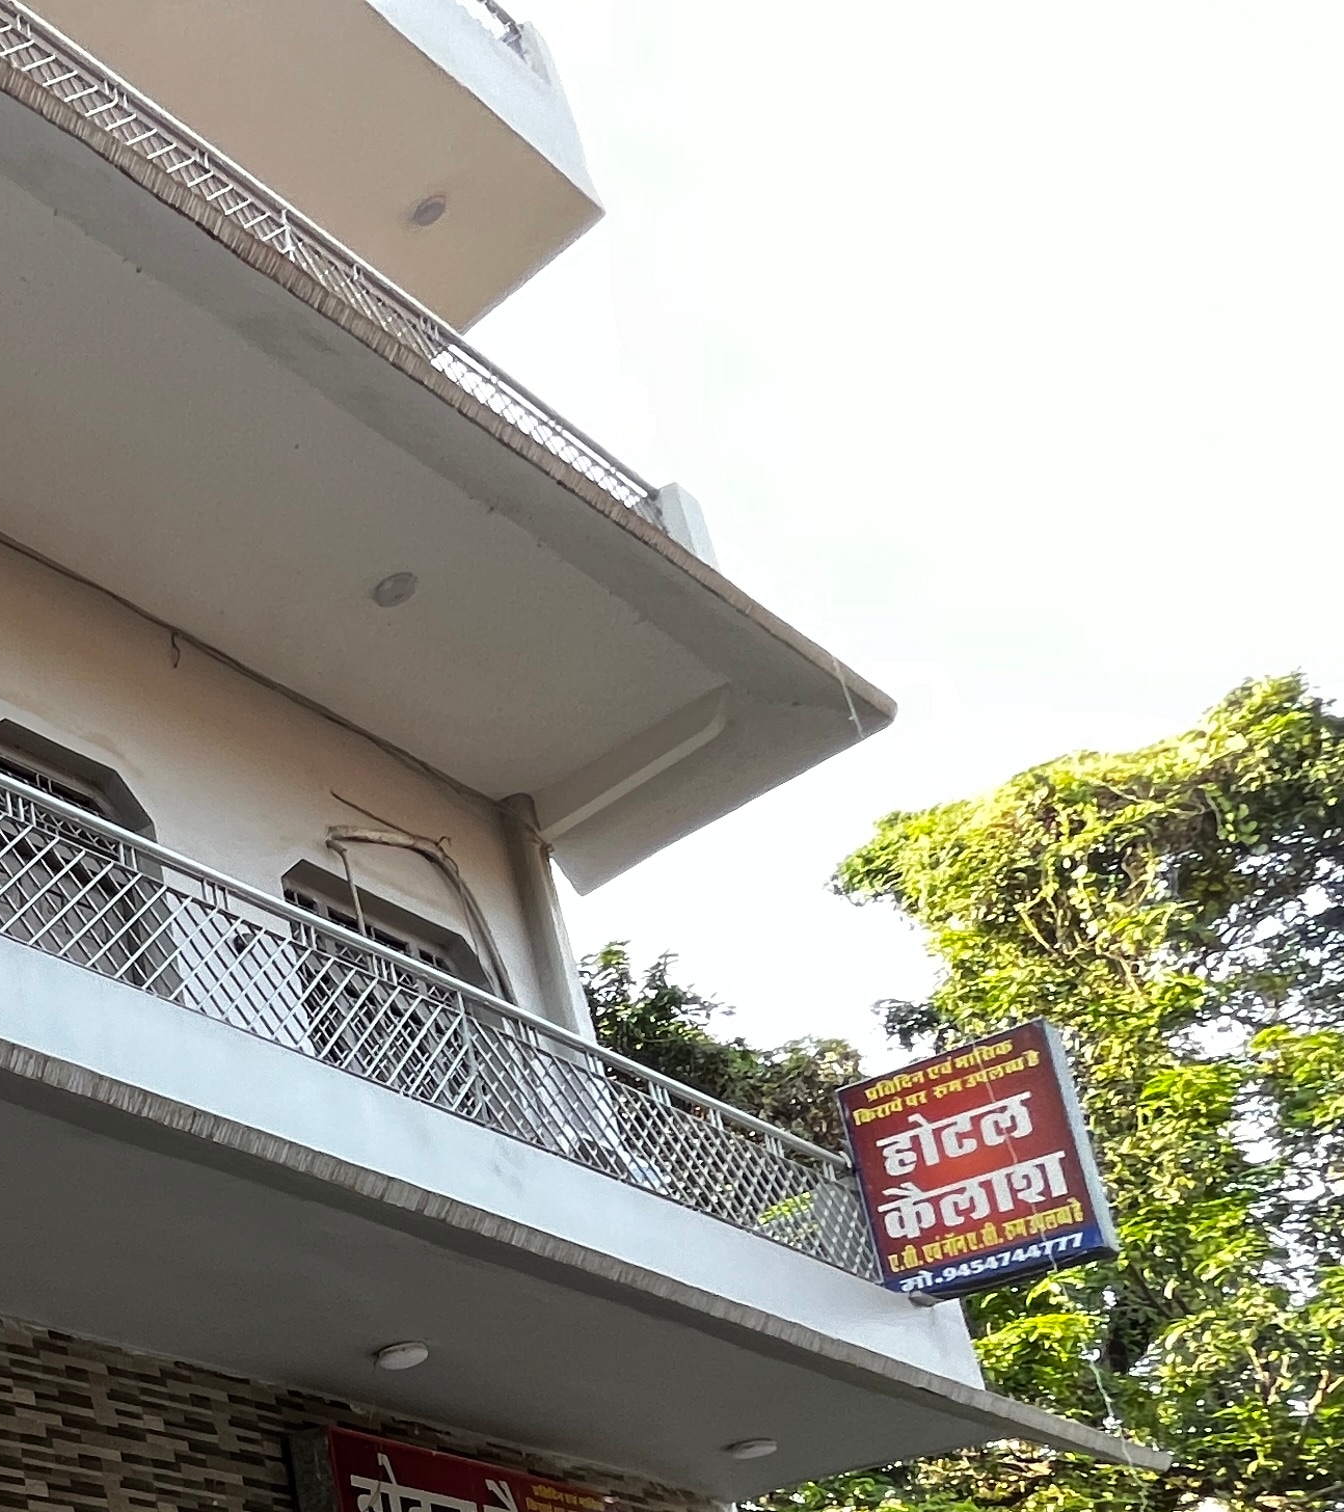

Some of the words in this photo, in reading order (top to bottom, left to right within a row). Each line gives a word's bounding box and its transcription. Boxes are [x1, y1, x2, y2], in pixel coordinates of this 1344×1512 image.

[852, 1096, 904, 1126] किराये
[904, 1090, 928, 1107] पर
[1022, 1049, 1041, 1068] है
[926, 1056, 953, 1080] एवं
[876, 1091, 1033, 1177] होटल
[877, 1150, 1069, 1240] कैलाश
